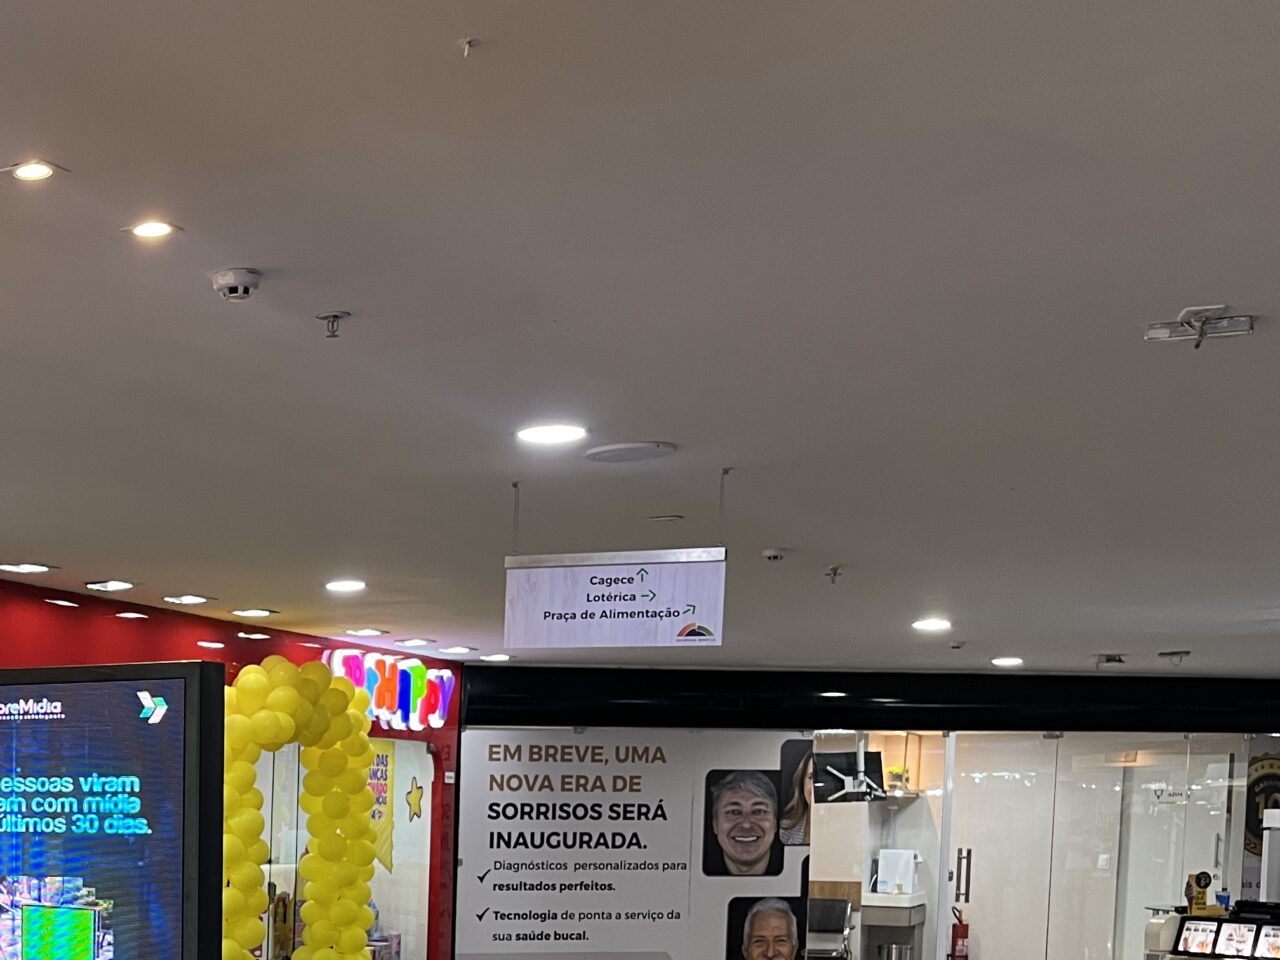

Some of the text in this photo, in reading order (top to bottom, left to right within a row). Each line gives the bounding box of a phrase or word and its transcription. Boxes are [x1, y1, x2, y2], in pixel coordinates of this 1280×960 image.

[589, 575, 635, 588] Cagece
[586, 591, 637, 603] Lotérica
[543, 607, 681, 623] Praça de Alimentação
[487, 744, 667, 765] EM BREVE, UMA
[79, 772, 141, 793] viram
[488, 774, 642, 793] NOVA ERA DE
[31, 796, 78, 813] com
[83, 792, 141, 814] mídia
[487, 798, 668, 821] SORRISOS SERÁ
[71, 814, 99, 833] 30
[104, 814, 153, 835] dias.
[488, 831, 648, 850] INAUGURADA.
[493, 860, 688, 873] Diagnósticos personalizados para
[492, 880, 616, 893] resultados perfeitos.
[493, 909, 681, 923] Tecnologia de ponta a serviço da
[492, 930, 590, 942] sua saúde bucal.
